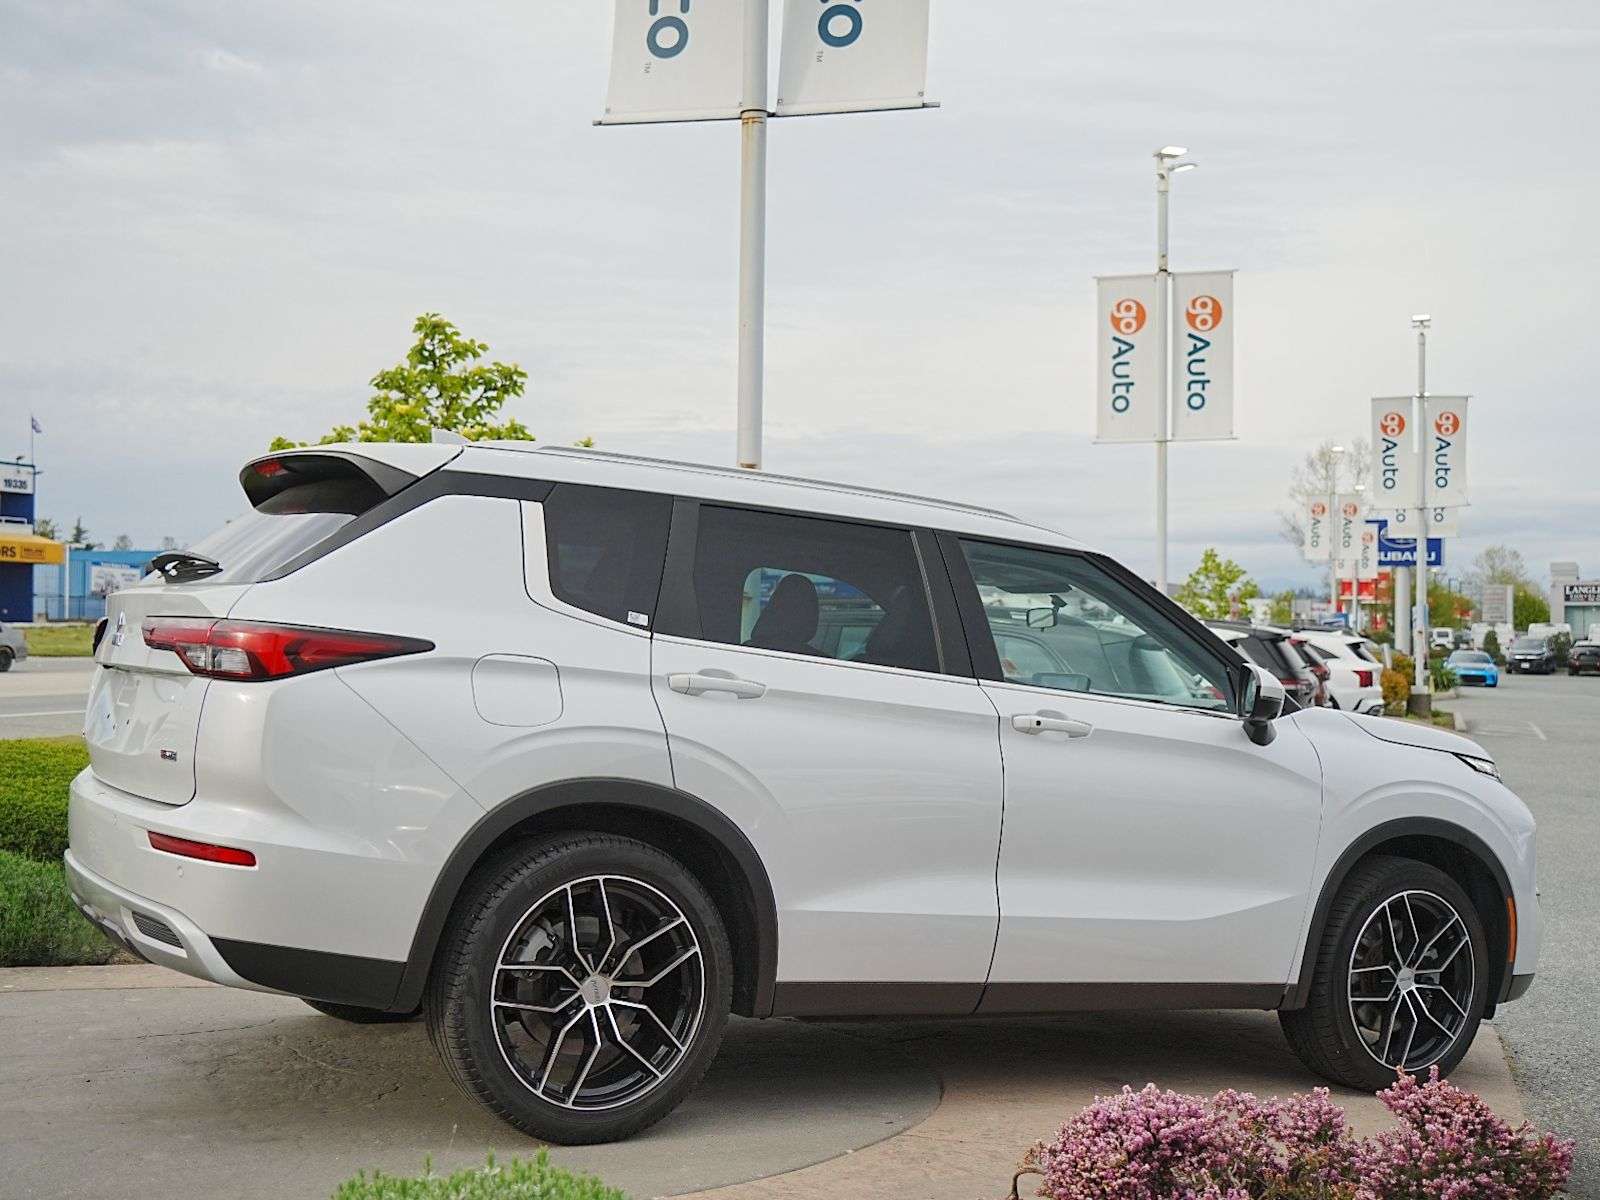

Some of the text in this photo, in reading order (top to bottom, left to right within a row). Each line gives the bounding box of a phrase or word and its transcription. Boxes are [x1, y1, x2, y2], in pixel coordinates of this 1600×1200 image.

[817, 0, 862, 47] o
[1112, 336, 1135, 413] Auto
[1187, 333, 1211, 410] Auto
[1382, 437, 1398, 489] Auto
[1435, 437, 1451, 488] Auto
[0, 546, 17, 558] RS
[1311, 517, 1321, 548] Auto
[1342, 517, 1353, 548] Auto
[1379, 551, 1436, 561] UBAU
